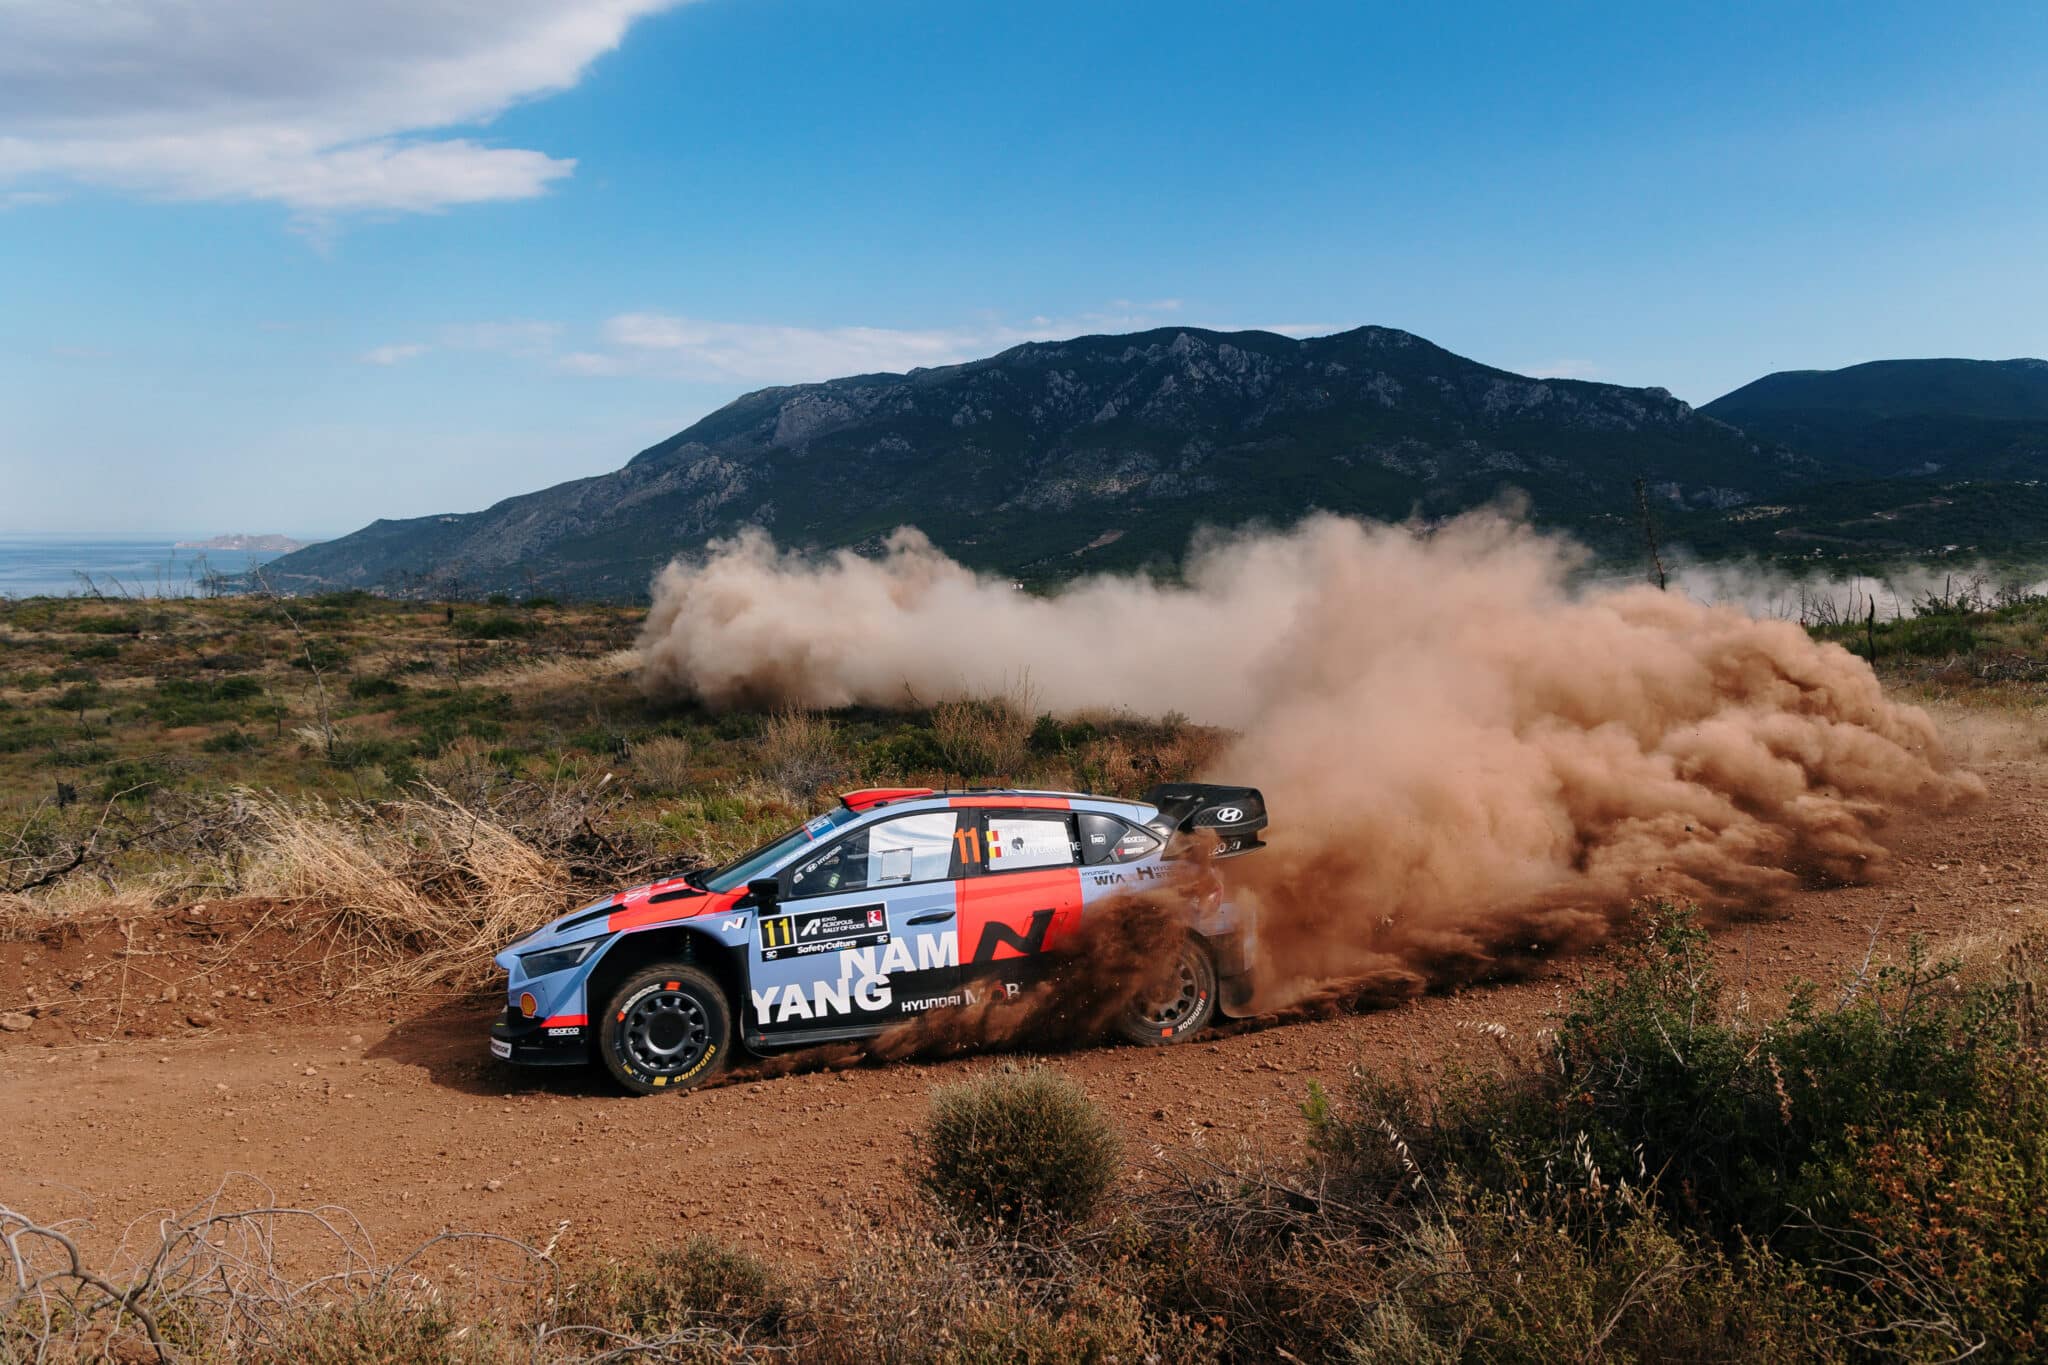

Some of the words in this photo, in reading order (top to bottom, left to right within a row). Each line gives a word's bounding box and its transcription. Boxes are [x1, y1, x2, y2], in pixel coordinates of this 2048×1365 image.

[953, 827, 982, 864] 11
[817, 845, 842, 865] HYUNDAI
[765, 918, 791, 947] 11
[822, 919, 854, 928] ACROPOLIS
[798, 940, 857, 954] SafetyCulture
[877, 935, 888, 943] SC
[766, 951, 778, 959] SC
[840, 931, 960, 979] NAM
[751, 974, 893, 1025] YANG
[901, 995, 961, 1012] HYUNDAI
